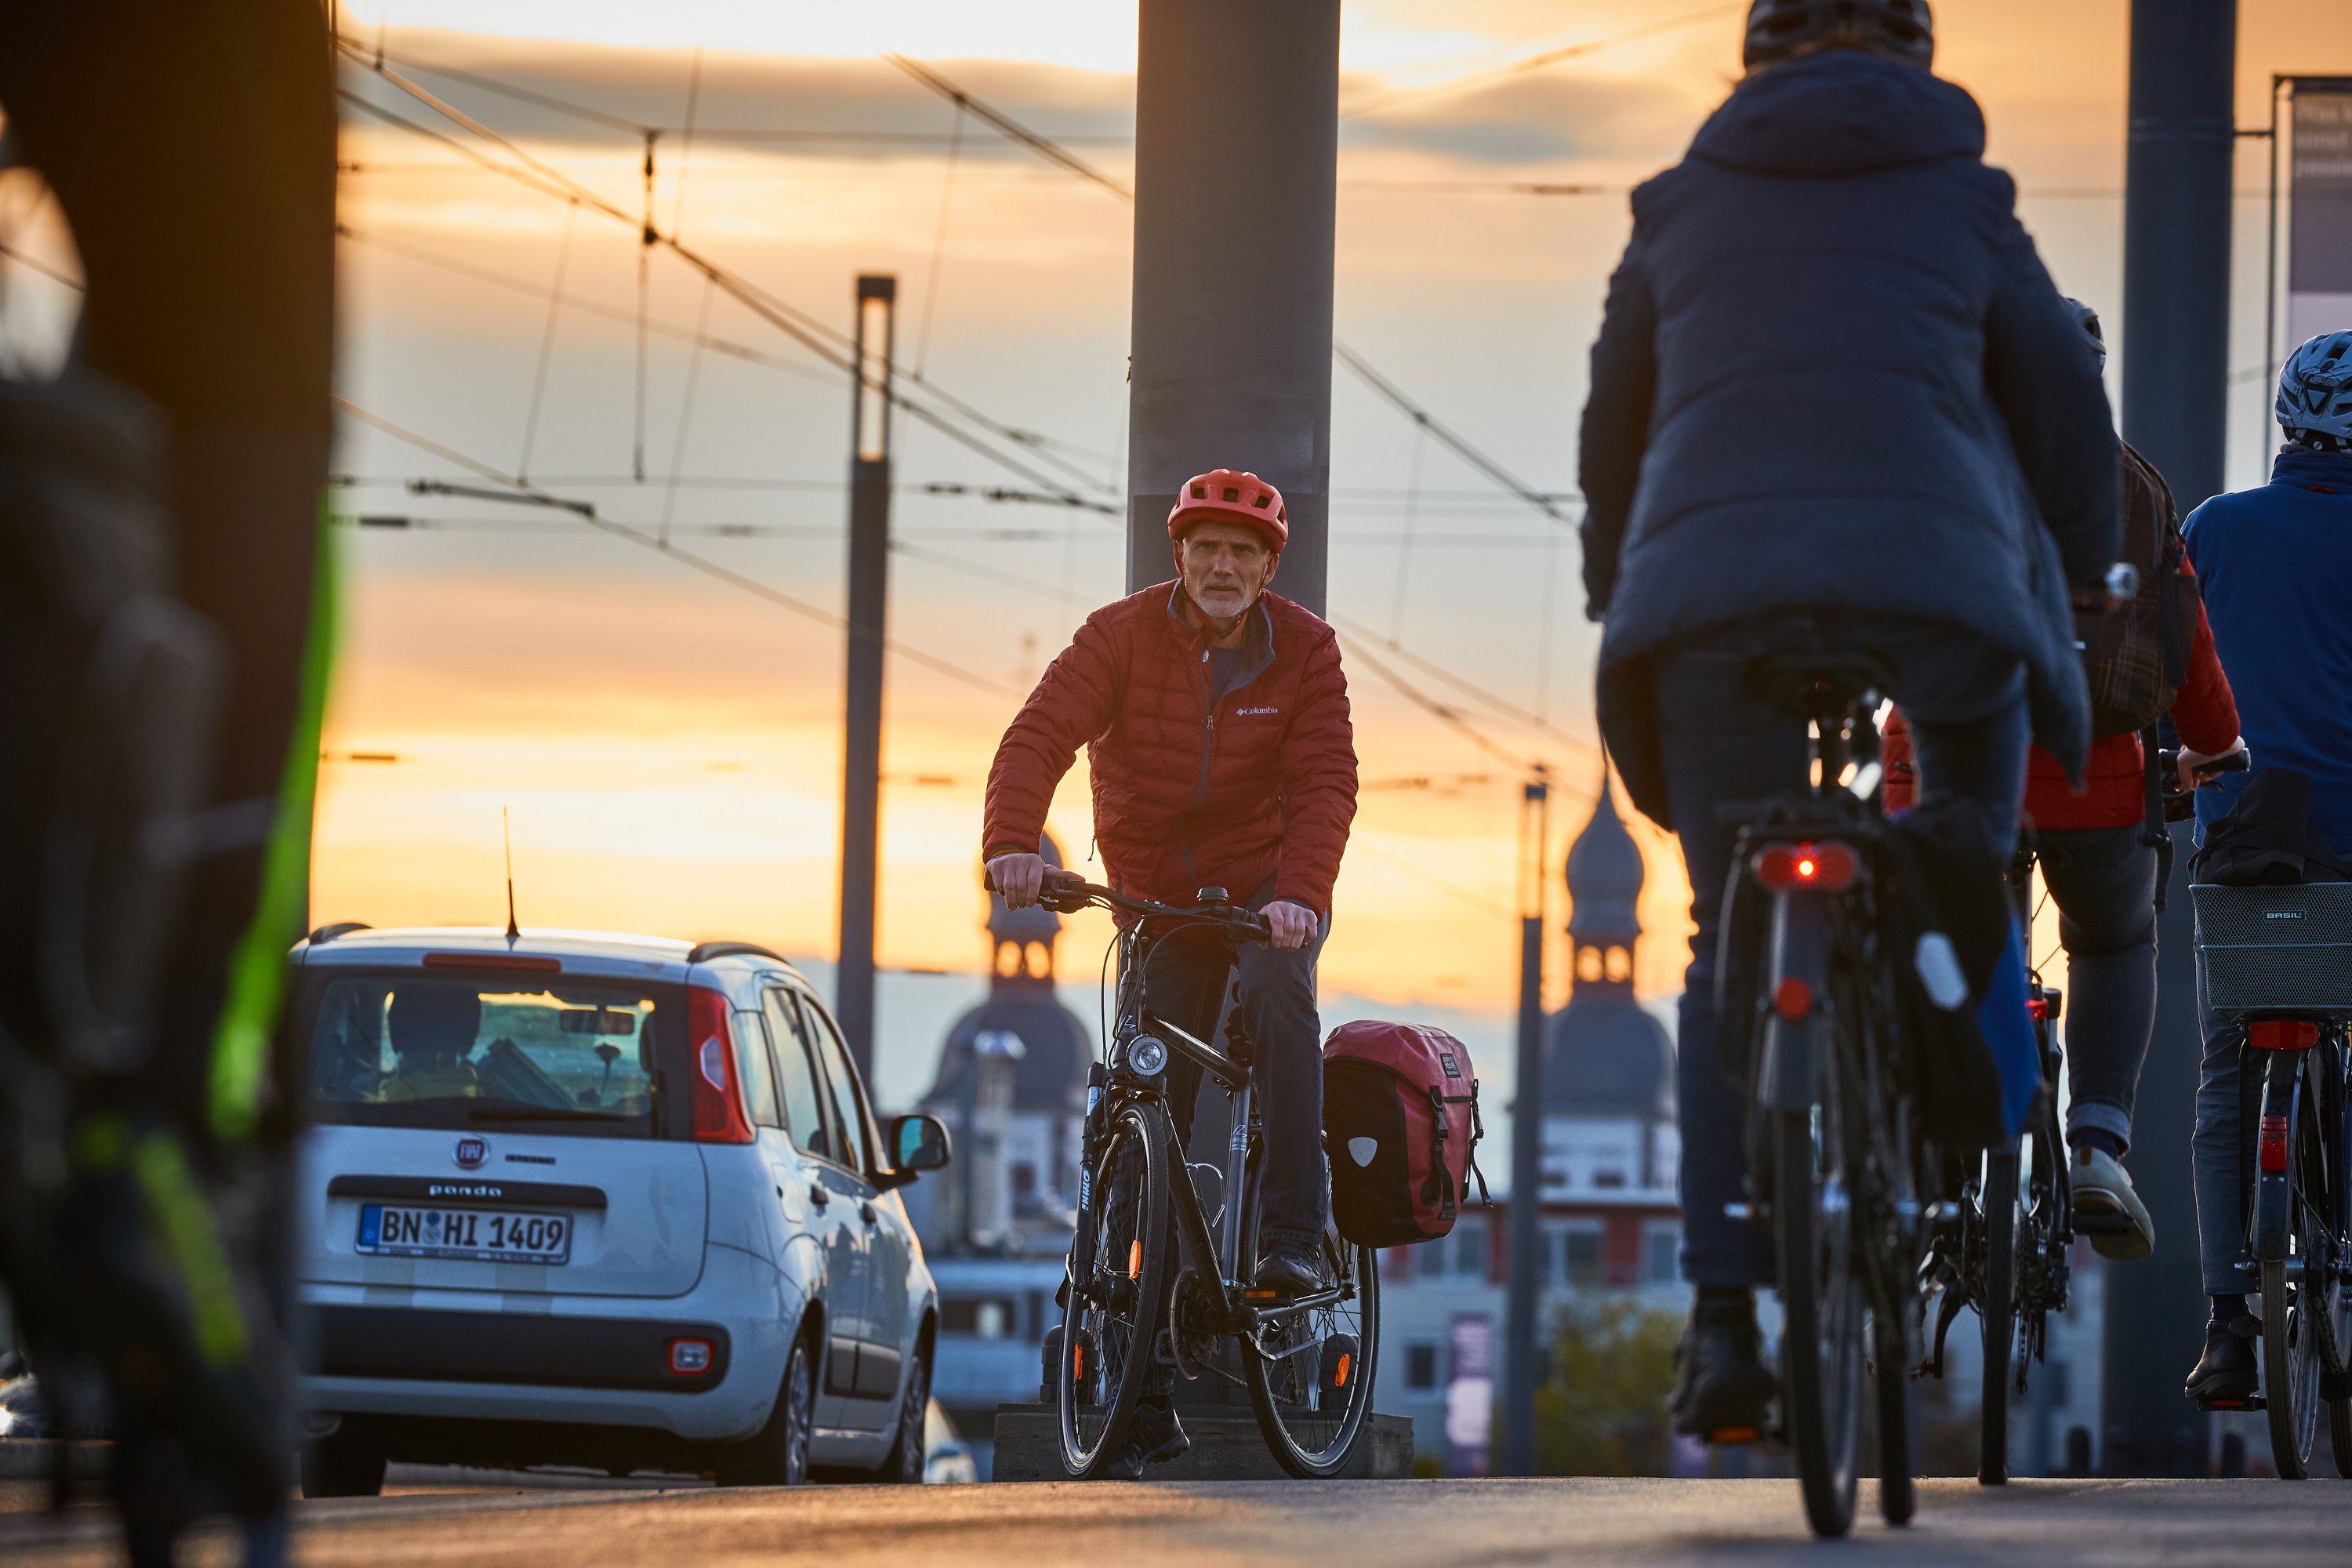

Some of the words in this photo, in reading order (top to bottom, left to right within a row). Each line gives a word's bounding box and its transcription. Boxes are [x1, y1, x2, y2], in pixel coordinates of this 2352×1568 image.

[1244, 706, 1278, 715] Columbia
[459, 1143, 481, 1159] FIAT
[429, 1185, 502, 1197] panda
[382, 1211, 422, 1243] BN
[443, 1214, 478, 1247] HI
[488, 1216, 564, 1251] 1409
